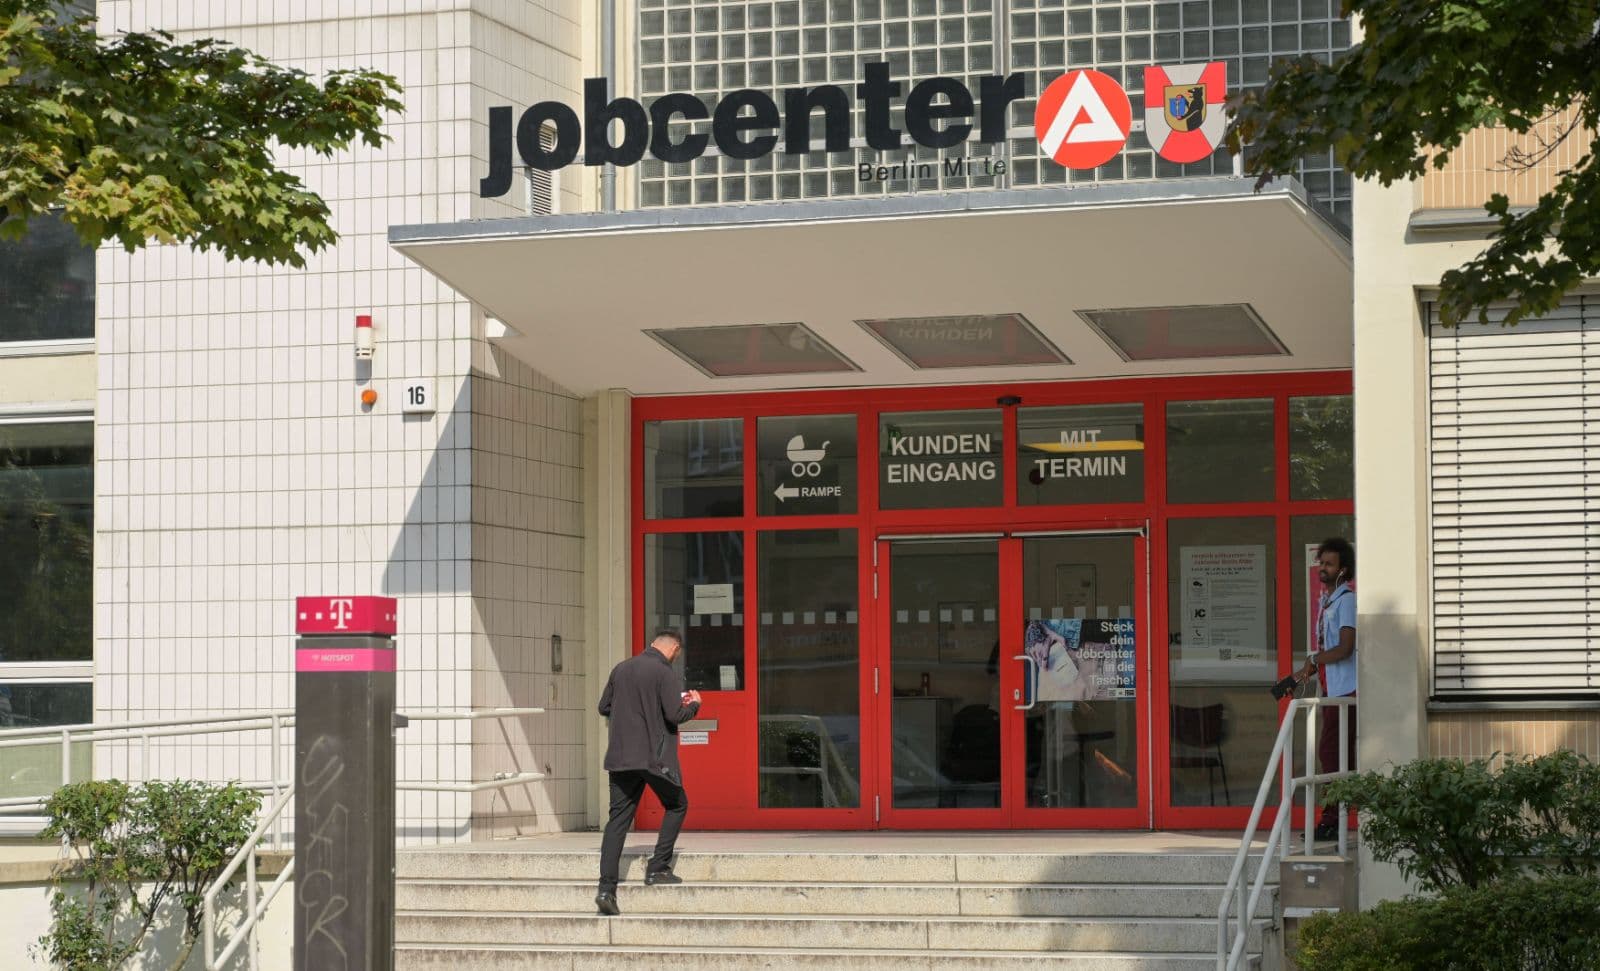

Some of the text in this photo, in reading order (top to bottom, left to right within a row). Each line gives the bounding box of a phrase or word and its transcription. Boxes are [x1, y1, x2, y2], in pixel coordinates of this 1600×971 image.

[480, 62, 1025, 198] jobcenter
[858, 156, 1007, 182] Berlin Mite
[407, 386, 425, 405] 16
[891, 433, 991, 456] KUNDEN
[1060, 429, 1101, 449] MIT
[887, 461, 996, 483] EINGANG
[1034, 456, 1126, 478] TERMIN
[801, 486, 842, 497] RAMPE
[1101, 621, 1135, 633] Steck
[1109, 635, 1134, 645] dein
[1075, 649, 1134, 659] Jobcenter
[1117, 661, 1135, 672] die
[1089, 674, 1134, 686] Tasche!
